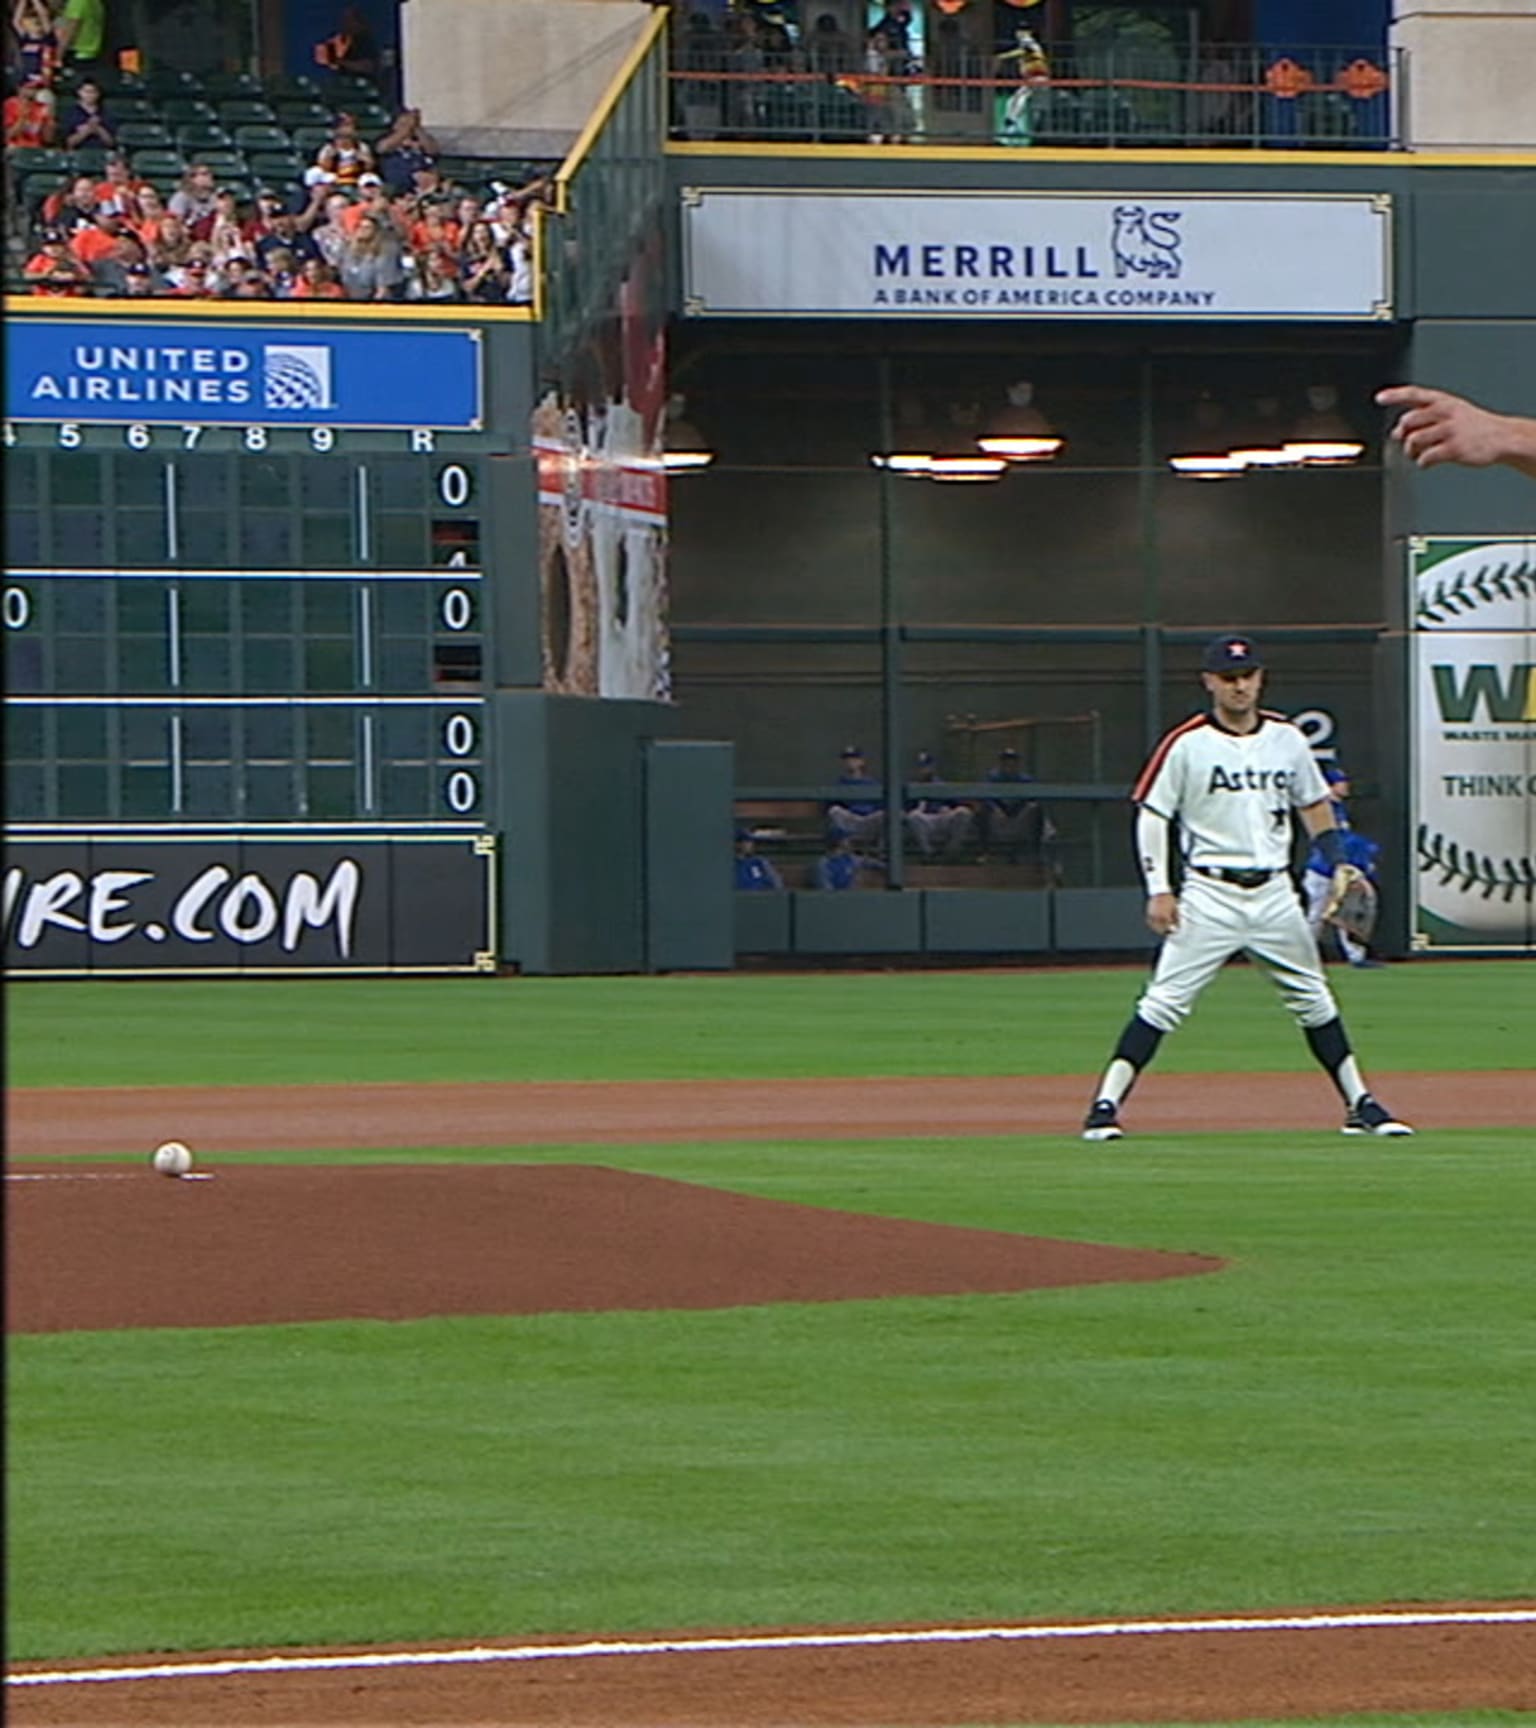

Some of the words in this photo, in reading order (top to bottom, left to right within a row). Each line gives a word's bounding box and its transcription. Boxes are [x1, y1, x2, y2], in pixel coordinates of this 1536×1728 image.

[874, 244, 1099, 277] MERRILL
[874, 289, 889, 304] A
[898, 289, 959, 304] BANK
[963, 289, 991, 304] OF
[999, 289, 1098, 305] AMERICA
[1105, 290, 1214, 305] COMPANY
[75, 346, 250, 372] UNITED
[31, 375, 250, 403] AIRLINES
[59, 424, 81, 447] 5
[128, 425, 150, 449] 6
[182, 426, 201, 449] 7
[246, 427, 267, 450] 8
[311, 427, 334, 451] 9
[412, 430, 434, 452] R
[441, 465, 469, 505] 0
[443, 588, 470, 630] 0
[447, 714, 473, 755] 0
[449, 771, 475, 812] 0
[1443, 775, 1522, 797] THINK
